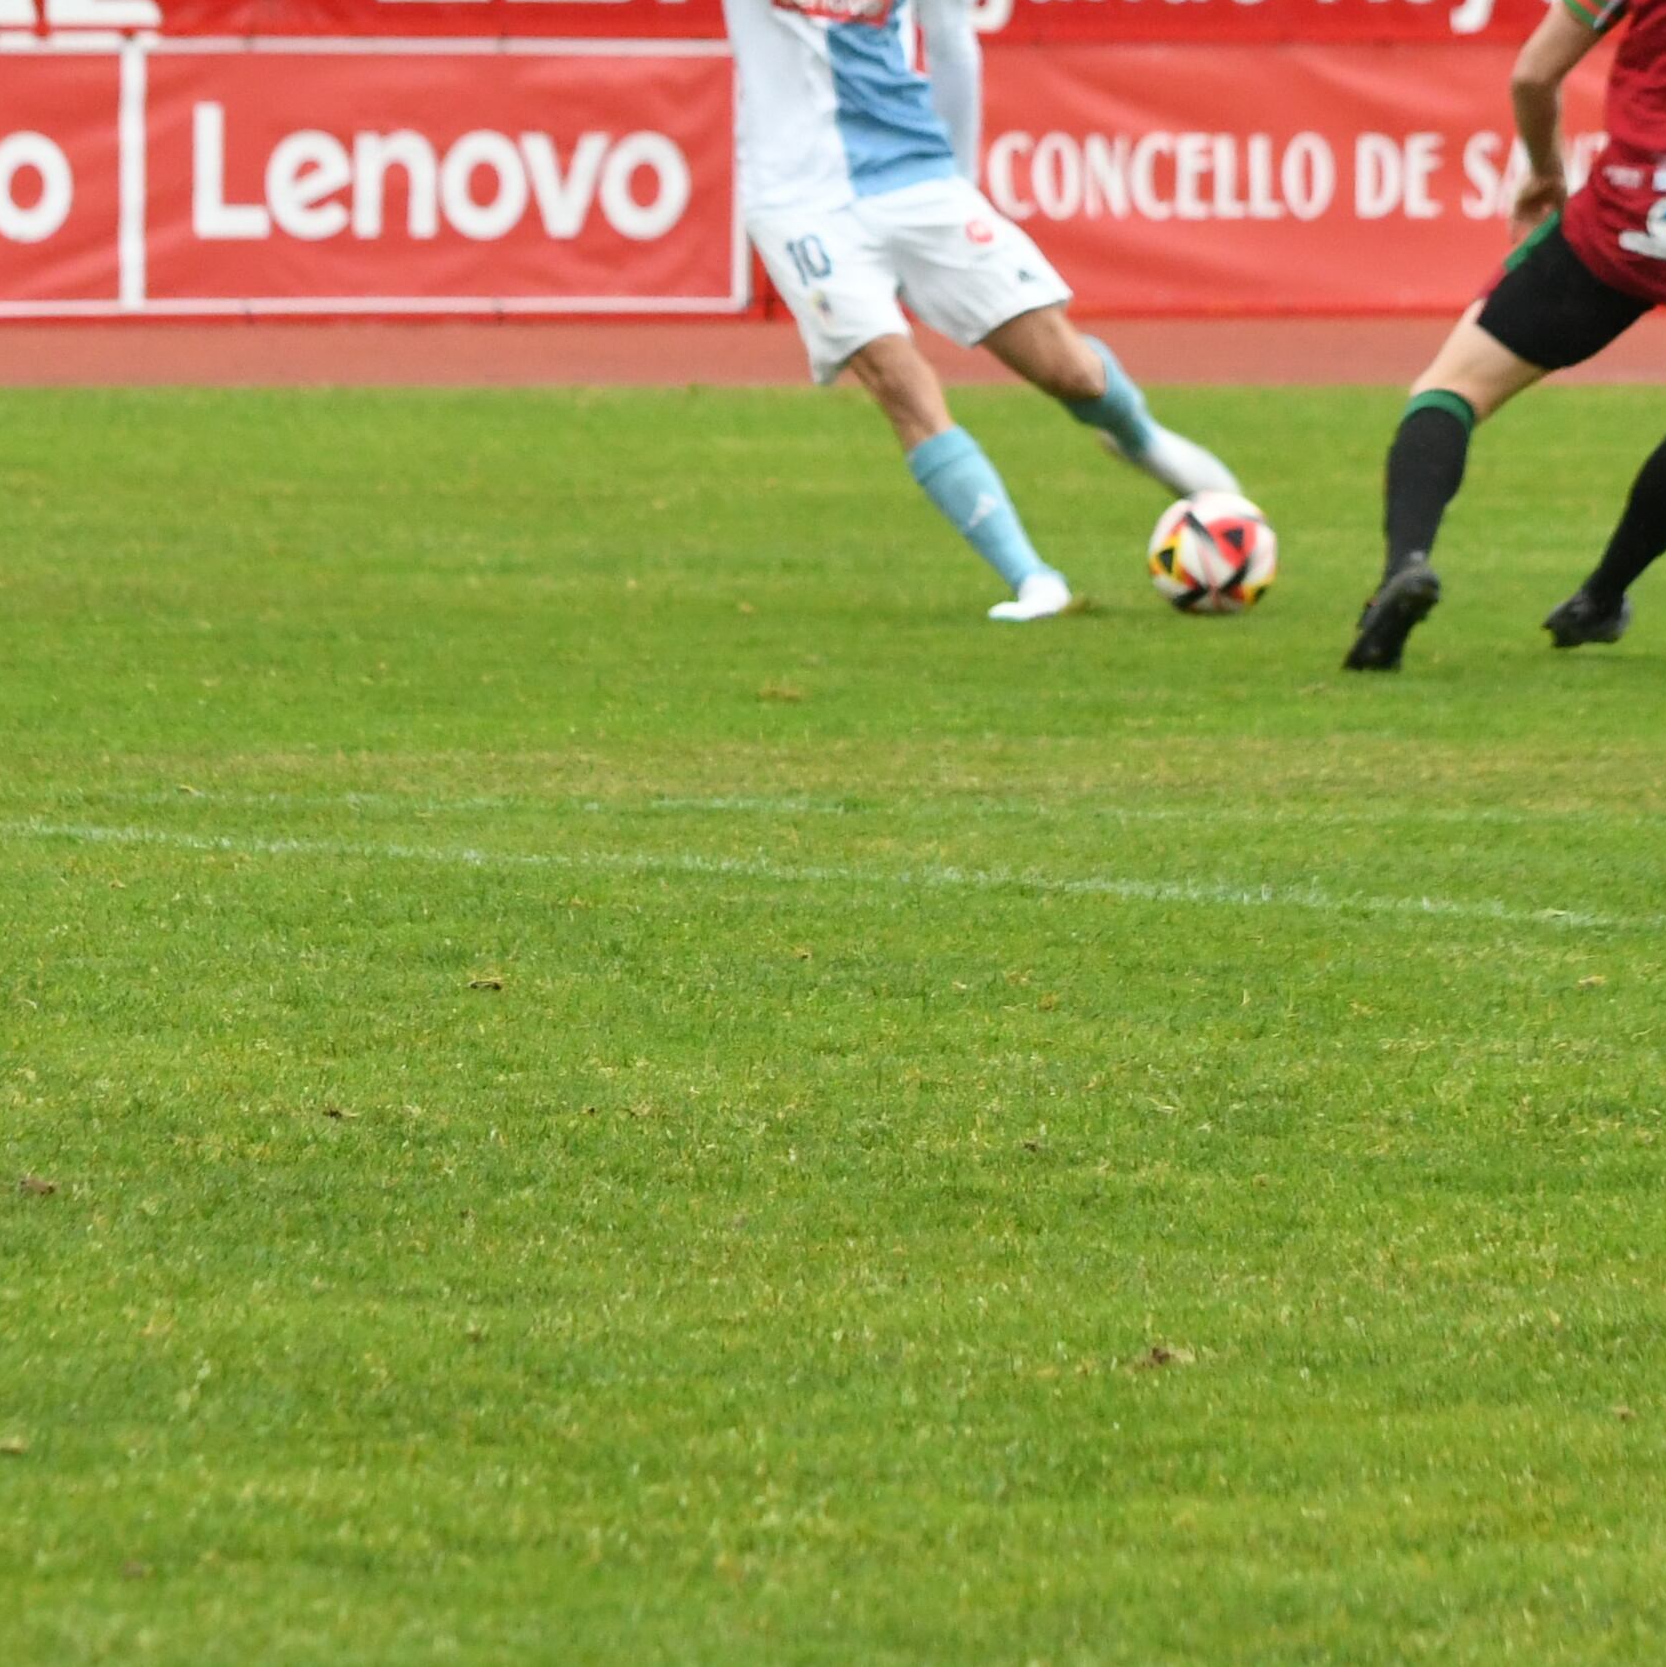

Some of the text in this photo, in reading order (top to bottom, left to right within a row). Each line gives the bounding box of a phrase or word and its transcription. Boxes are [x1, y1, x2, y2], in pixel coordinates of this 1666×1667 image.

[191, 100, 692, 241] Lenovo
[985, 130, 1335, 221] CONCELLO
[1355, 131, 1443, 220] DE
[786, 234, 832, 286] 10
